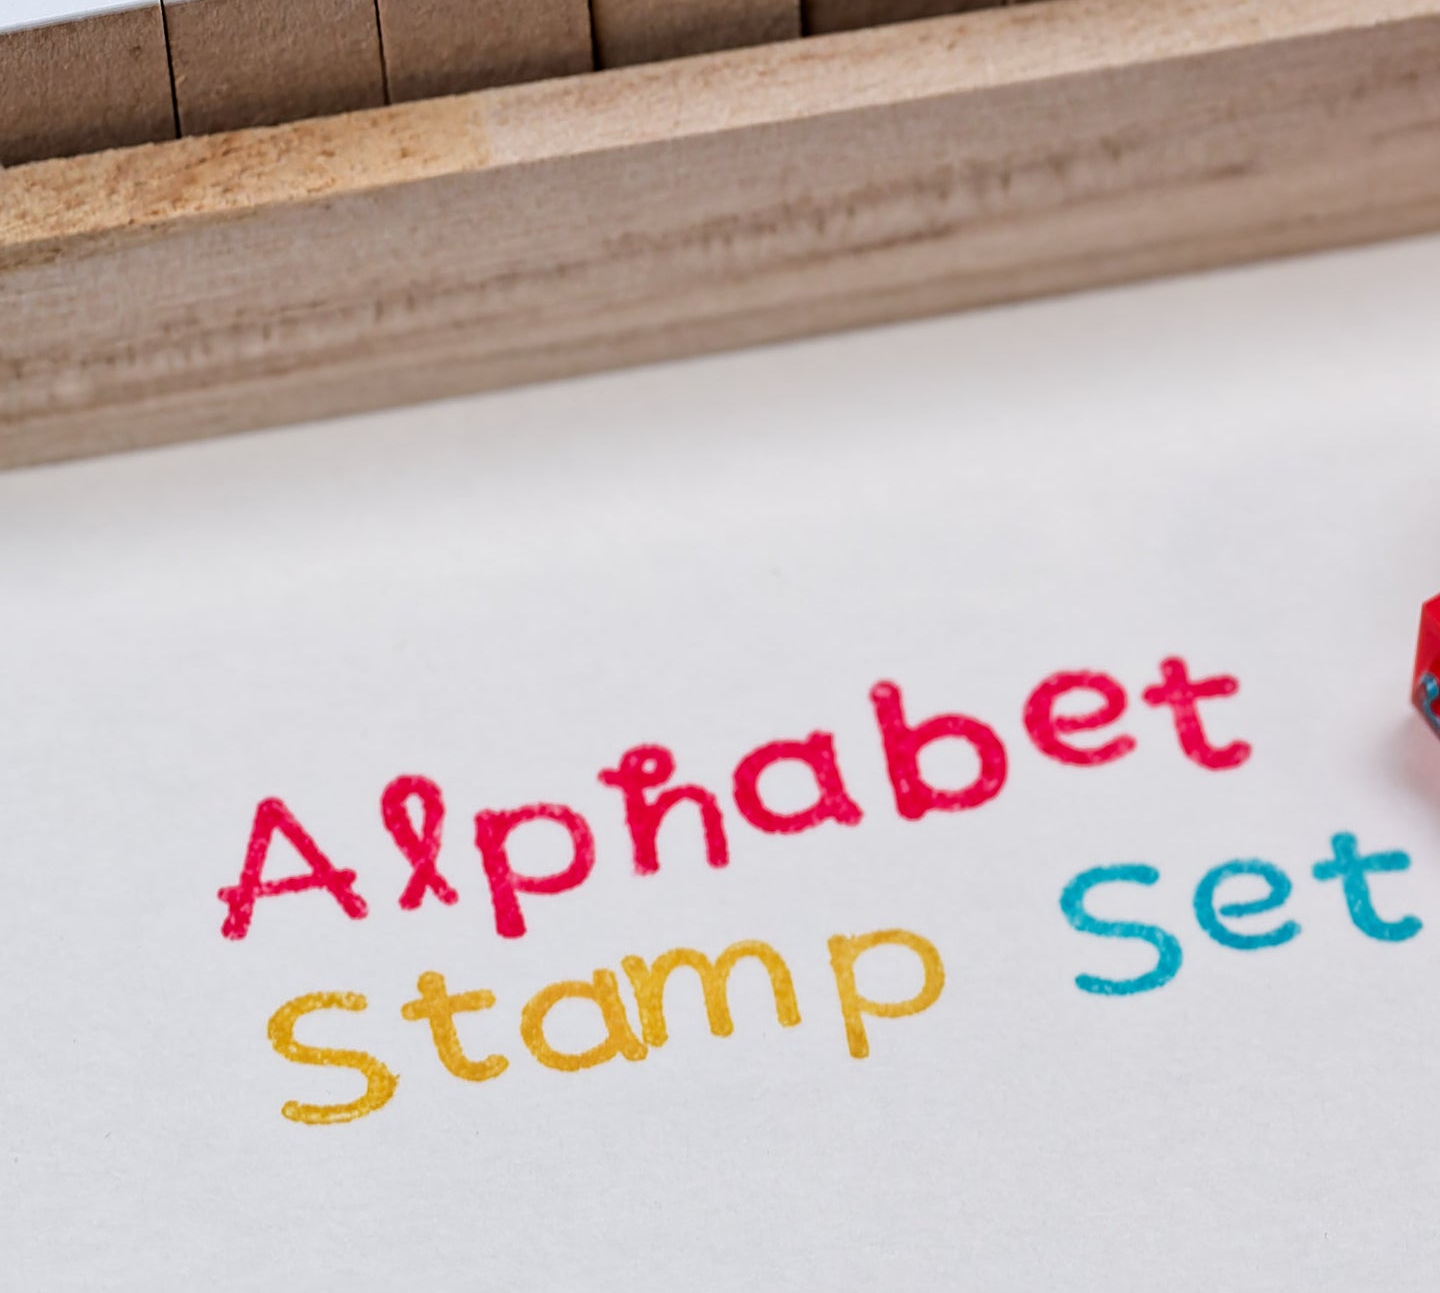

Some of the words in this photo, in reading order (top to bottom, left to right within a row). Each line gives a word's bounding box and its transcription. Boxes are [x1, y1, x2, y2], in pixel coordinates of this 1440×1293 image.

[218, 657, 1251, 940] Alphabet
[267, 929, 945, 1125] Stamp
[1060, 832, 1422, 996] Set
